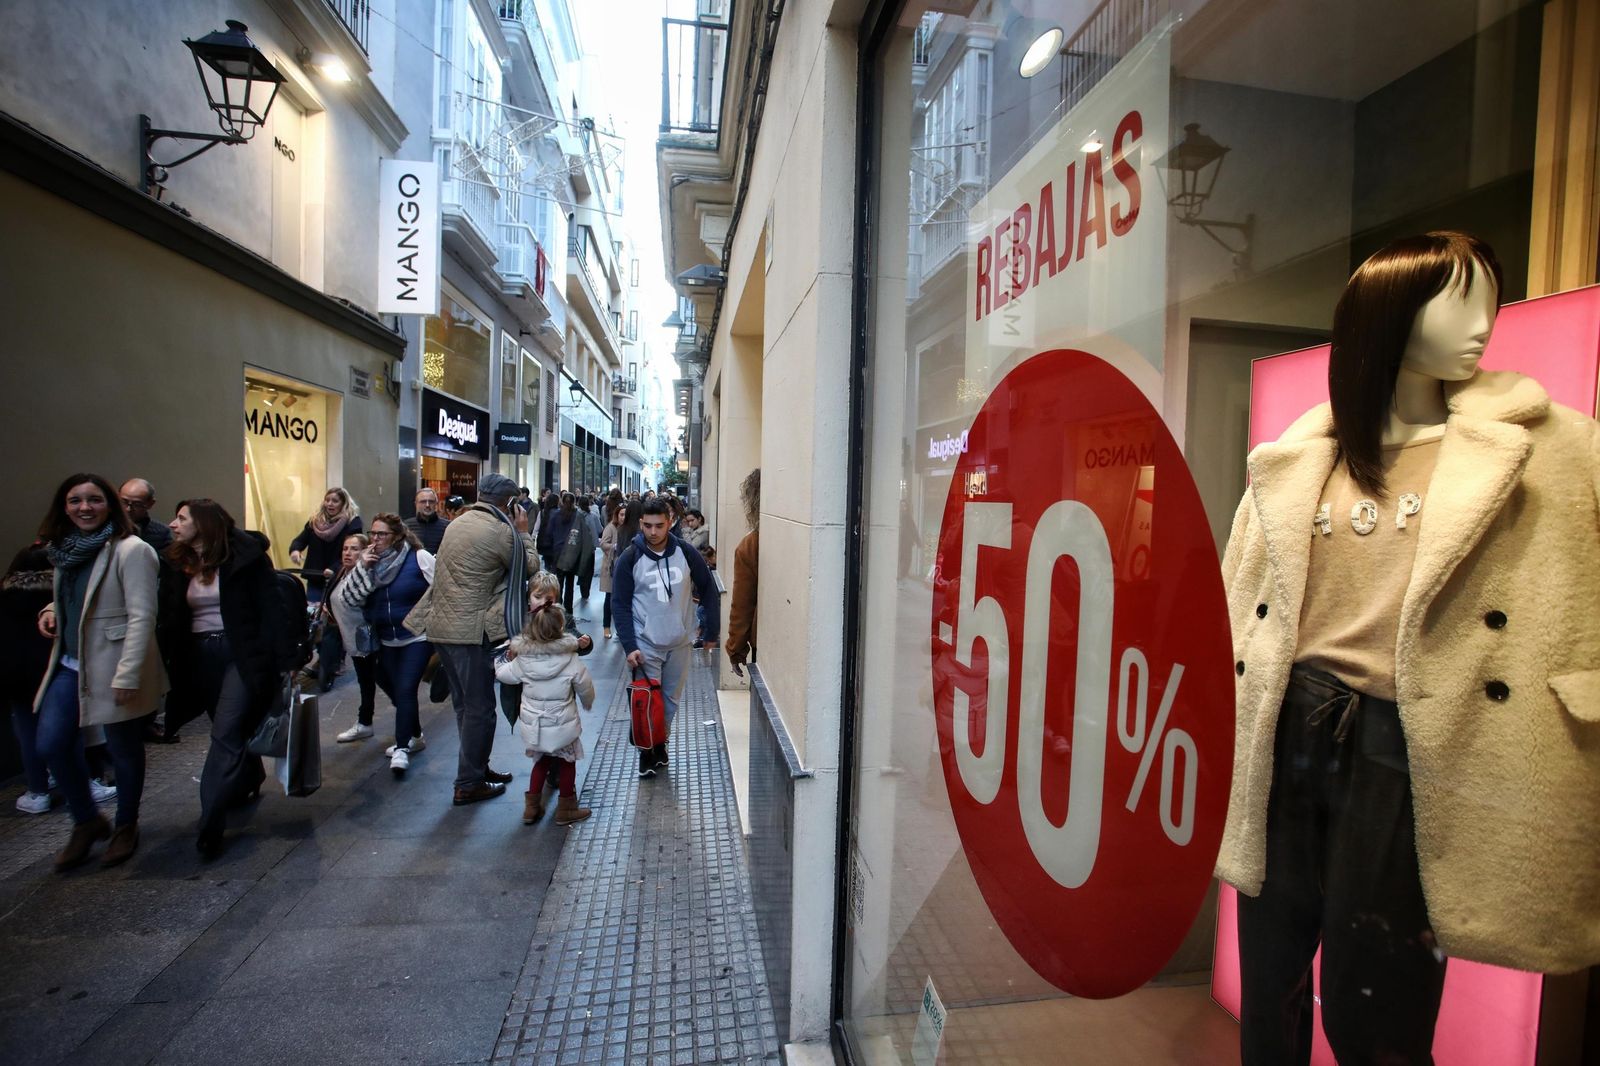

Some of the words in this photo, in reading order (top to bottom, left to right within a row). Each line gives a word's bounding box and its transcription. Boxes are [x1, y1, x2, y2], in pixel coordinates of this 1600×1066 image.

[396, 173, 420, 301] MANGO
[975, 110, 1143, 322] REBAJAS
[244, 408, 318, 444] MANGO
[939, 499, 1199, 889] -50%
